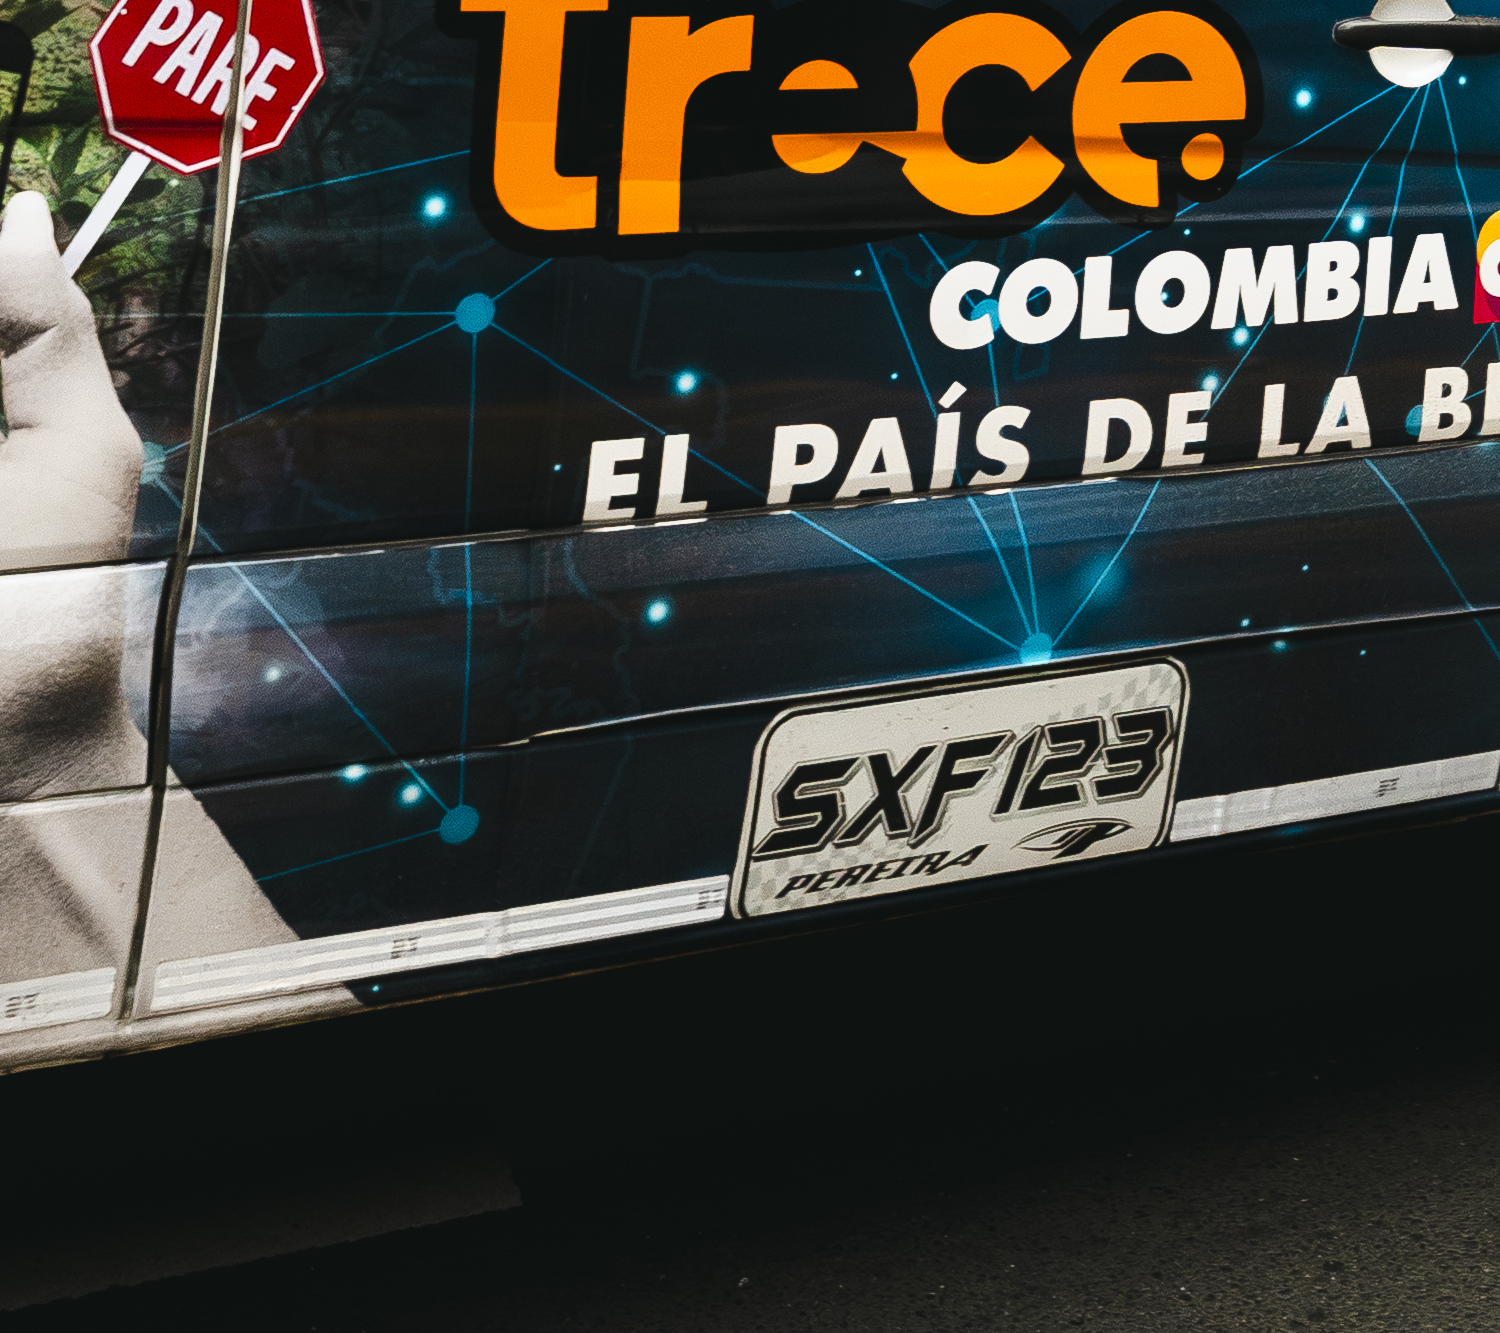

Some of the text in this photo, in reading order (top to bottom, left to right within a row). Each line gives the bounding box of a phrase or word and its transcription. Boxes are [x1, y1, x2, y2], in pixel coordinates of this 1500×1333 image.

[929, 233, 1460, 350] COLOMBIA
[581, 433, 708, 524] EL
[766, 381, 1031, 505] PAÍS
[1081, 391, 1217, 478] DE
[1257, 376, 1372, 460] LA
[752, 706, 1175, 859] SXF123
